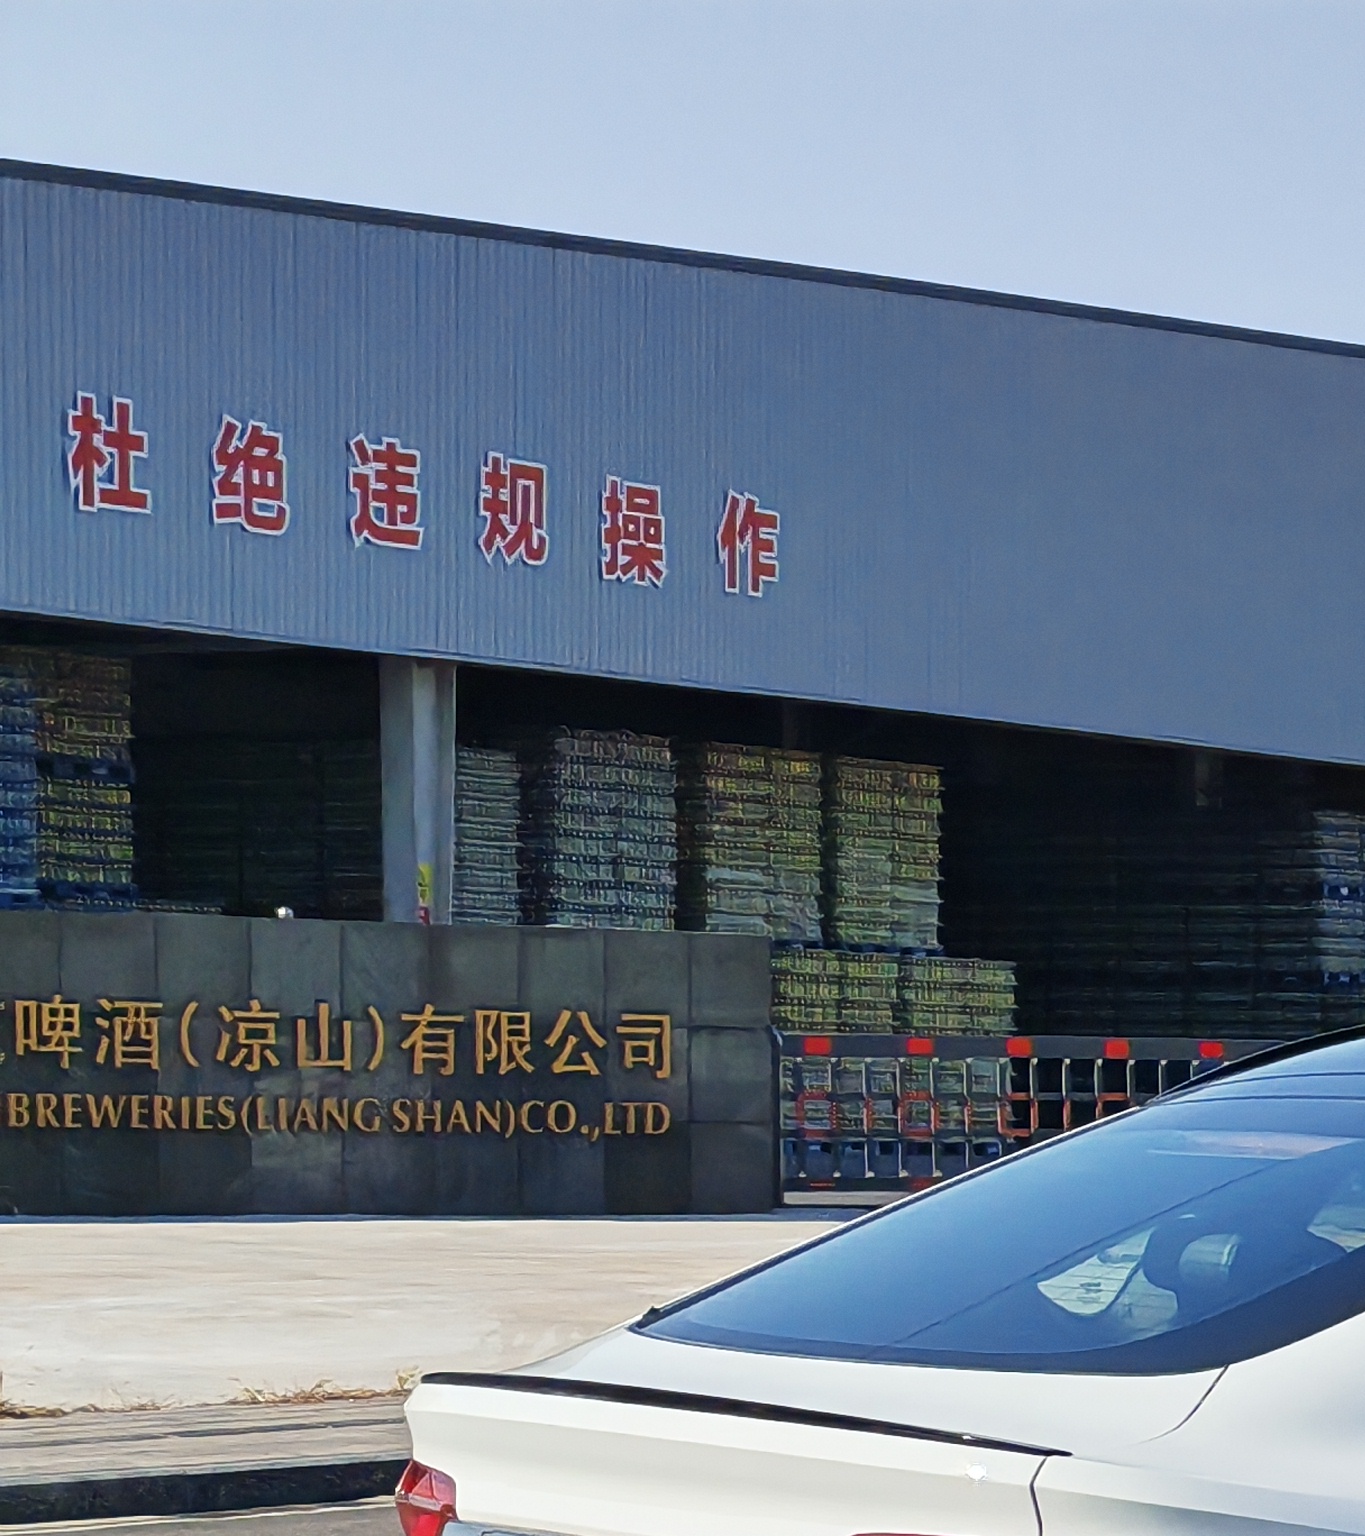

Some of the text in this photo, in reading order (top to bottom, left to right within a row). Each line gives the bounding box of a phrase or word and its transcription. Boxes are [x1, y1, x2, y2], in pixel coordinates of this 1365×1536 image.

[67, 390, 781, 597] 杜绝违规操作
[0, 994, 672, 1079] 啤酒(凉山)有限公司
